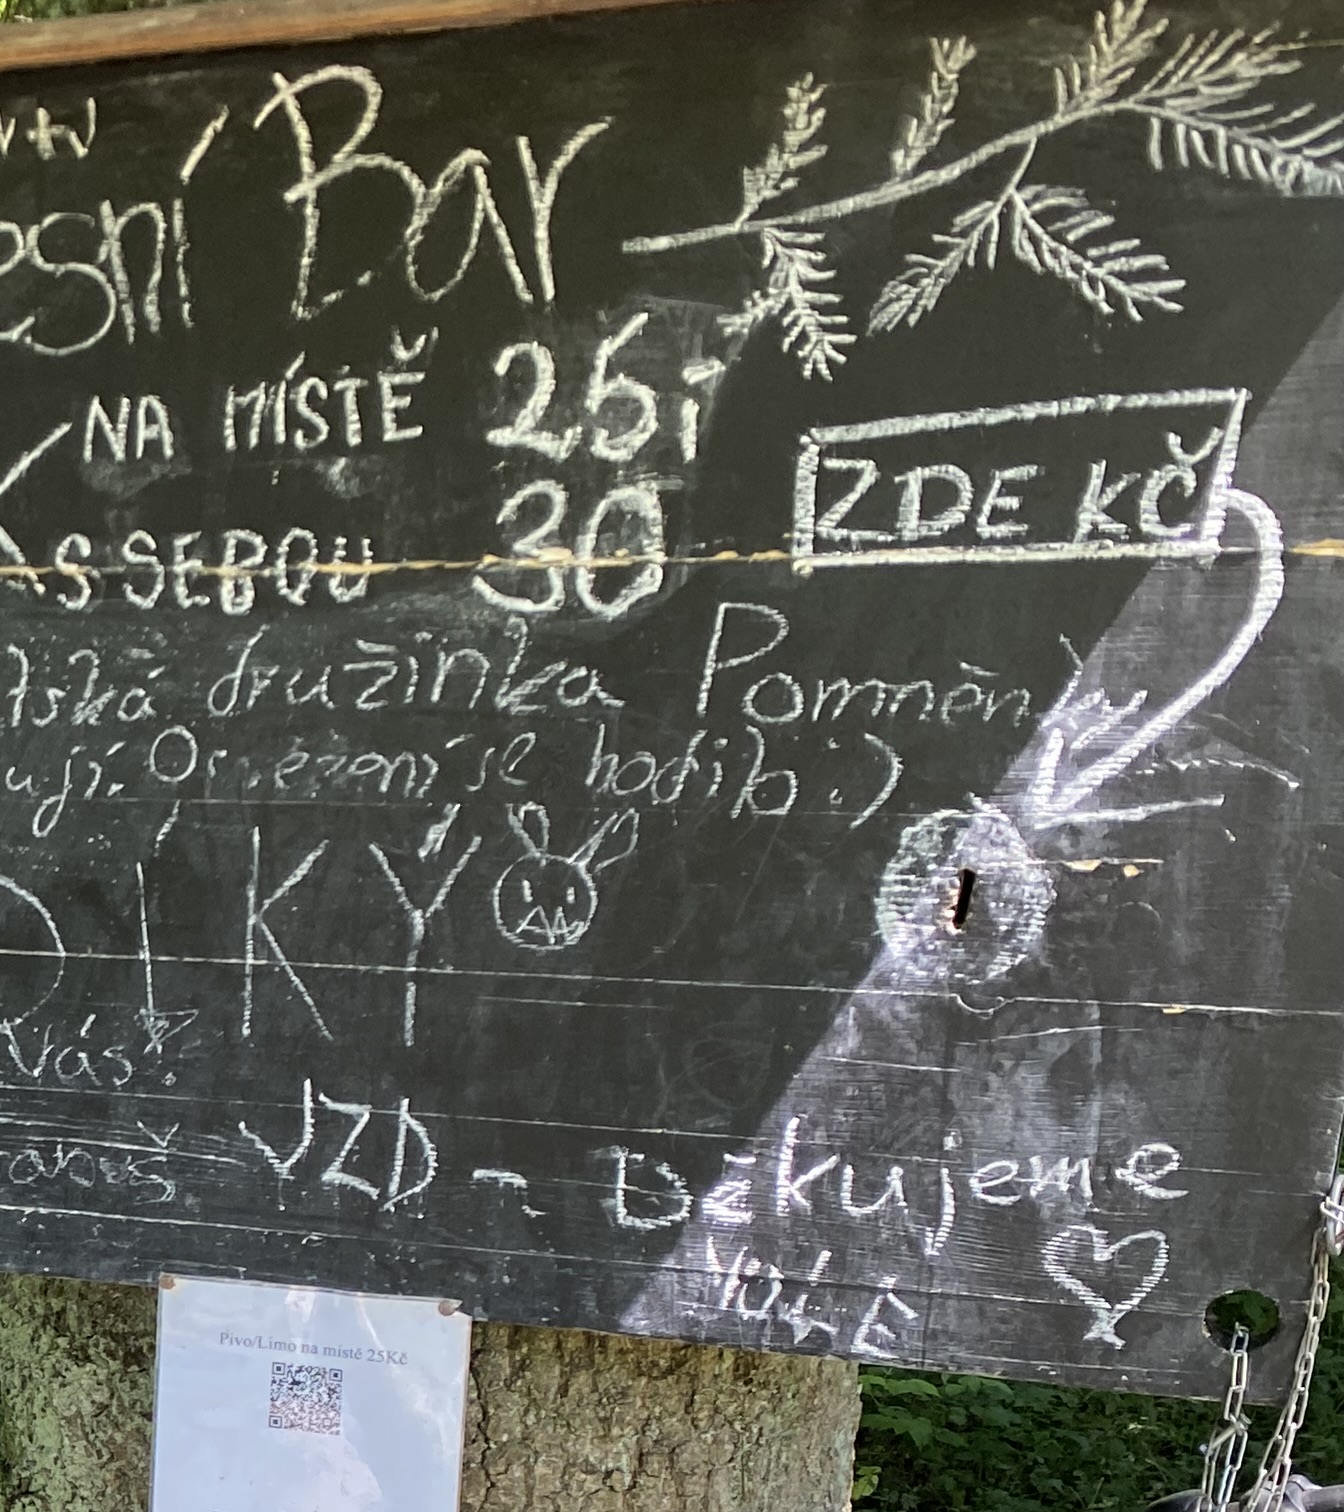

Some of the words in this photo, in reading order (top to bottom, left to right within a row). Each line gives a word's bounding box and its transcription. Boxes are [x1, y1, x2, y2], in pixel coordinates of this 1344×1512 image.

[254, 65, 616, 320] Bar
[84, 396, 174, 464] NA
[224, 328, 439, 455] MÍSTĚ
[815, 456, 1045, 542] ZDE
[1074, 426, 1222, 544] KČ
[54, 532, 100, 611] S
[123, 529, 373, 616] SEBOU
[219, 1331, 298, 1354] Pivo/Limo
[302, 1342, 319, 1355] na
[323, 1343, 363, 1361] místě
[367, 1347, 409, 1366] 25Kč
